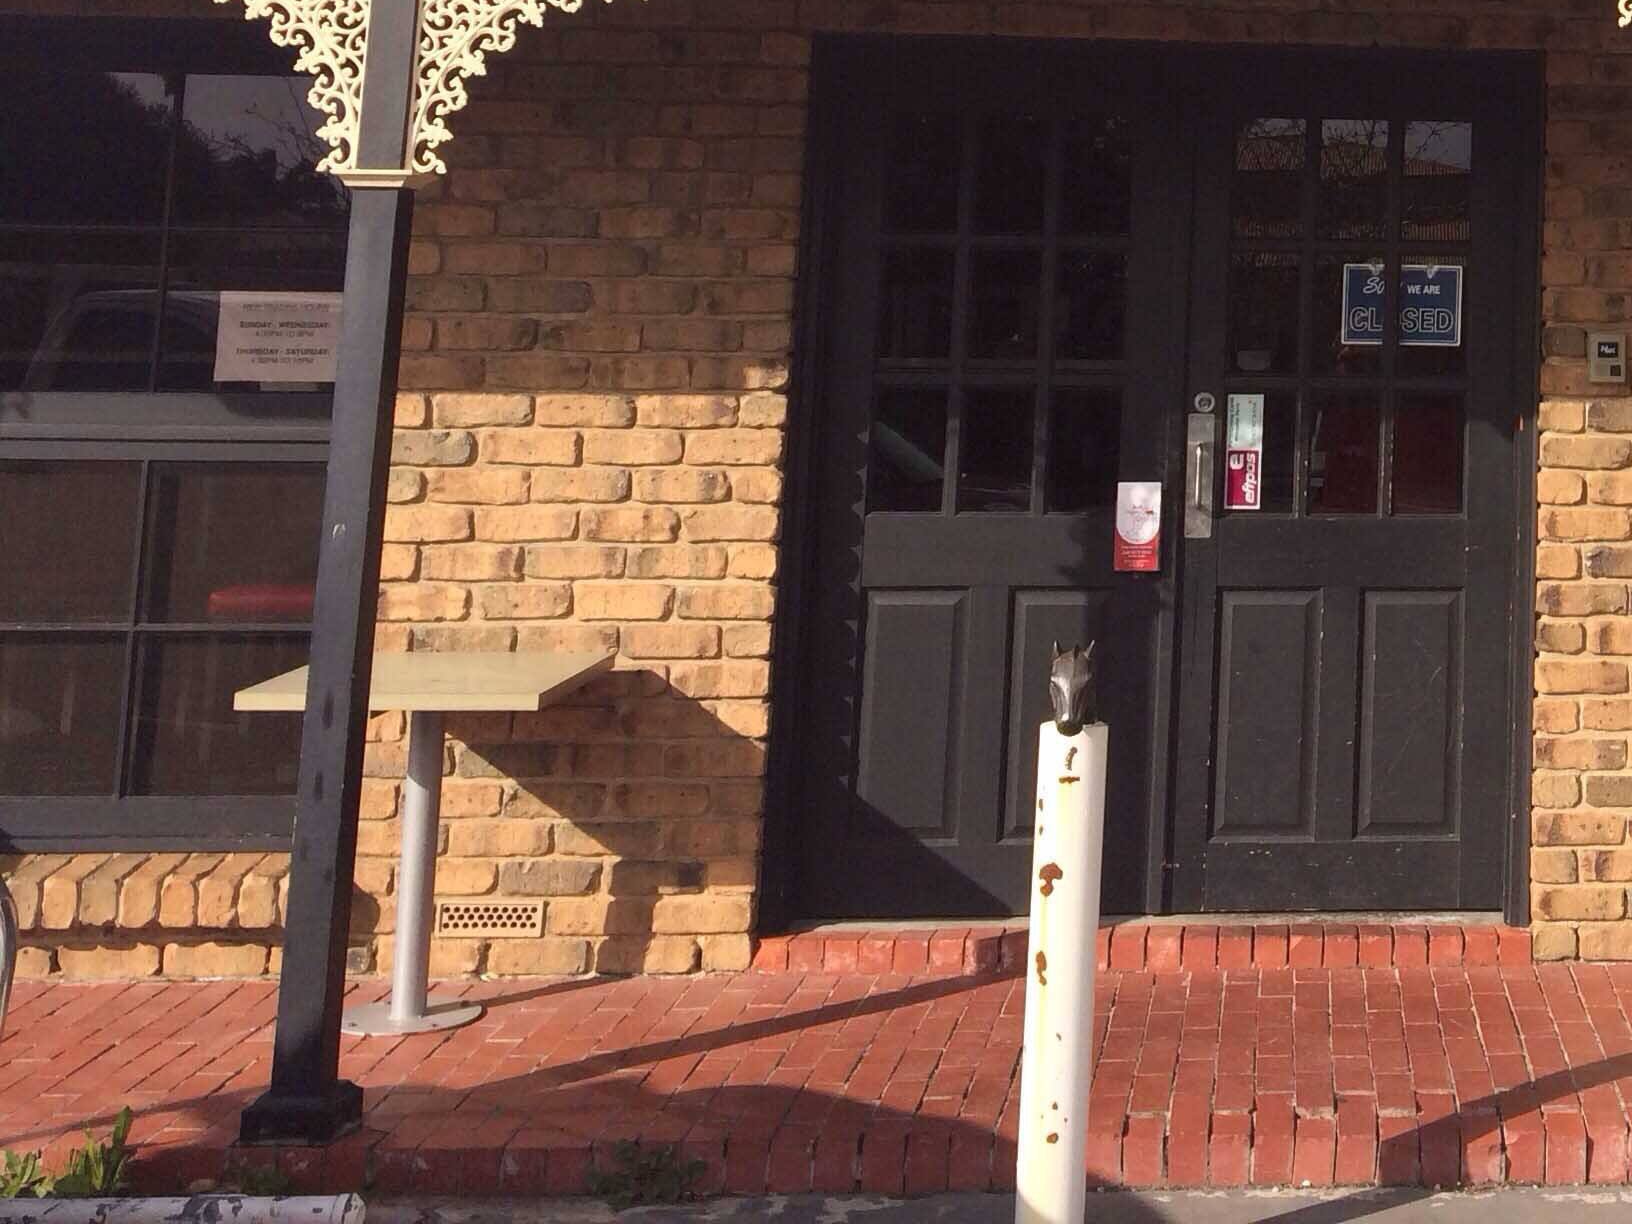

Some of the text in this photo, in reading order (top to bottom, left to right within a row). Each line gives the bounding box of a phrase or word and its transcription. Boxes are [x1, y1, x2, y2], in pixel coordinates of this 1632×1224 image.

[1406, 284, 1441, 295] WE ARE
[1349, 306, 1455, 333] CLSED
[1241, 452, 1257, 504] eftpos
